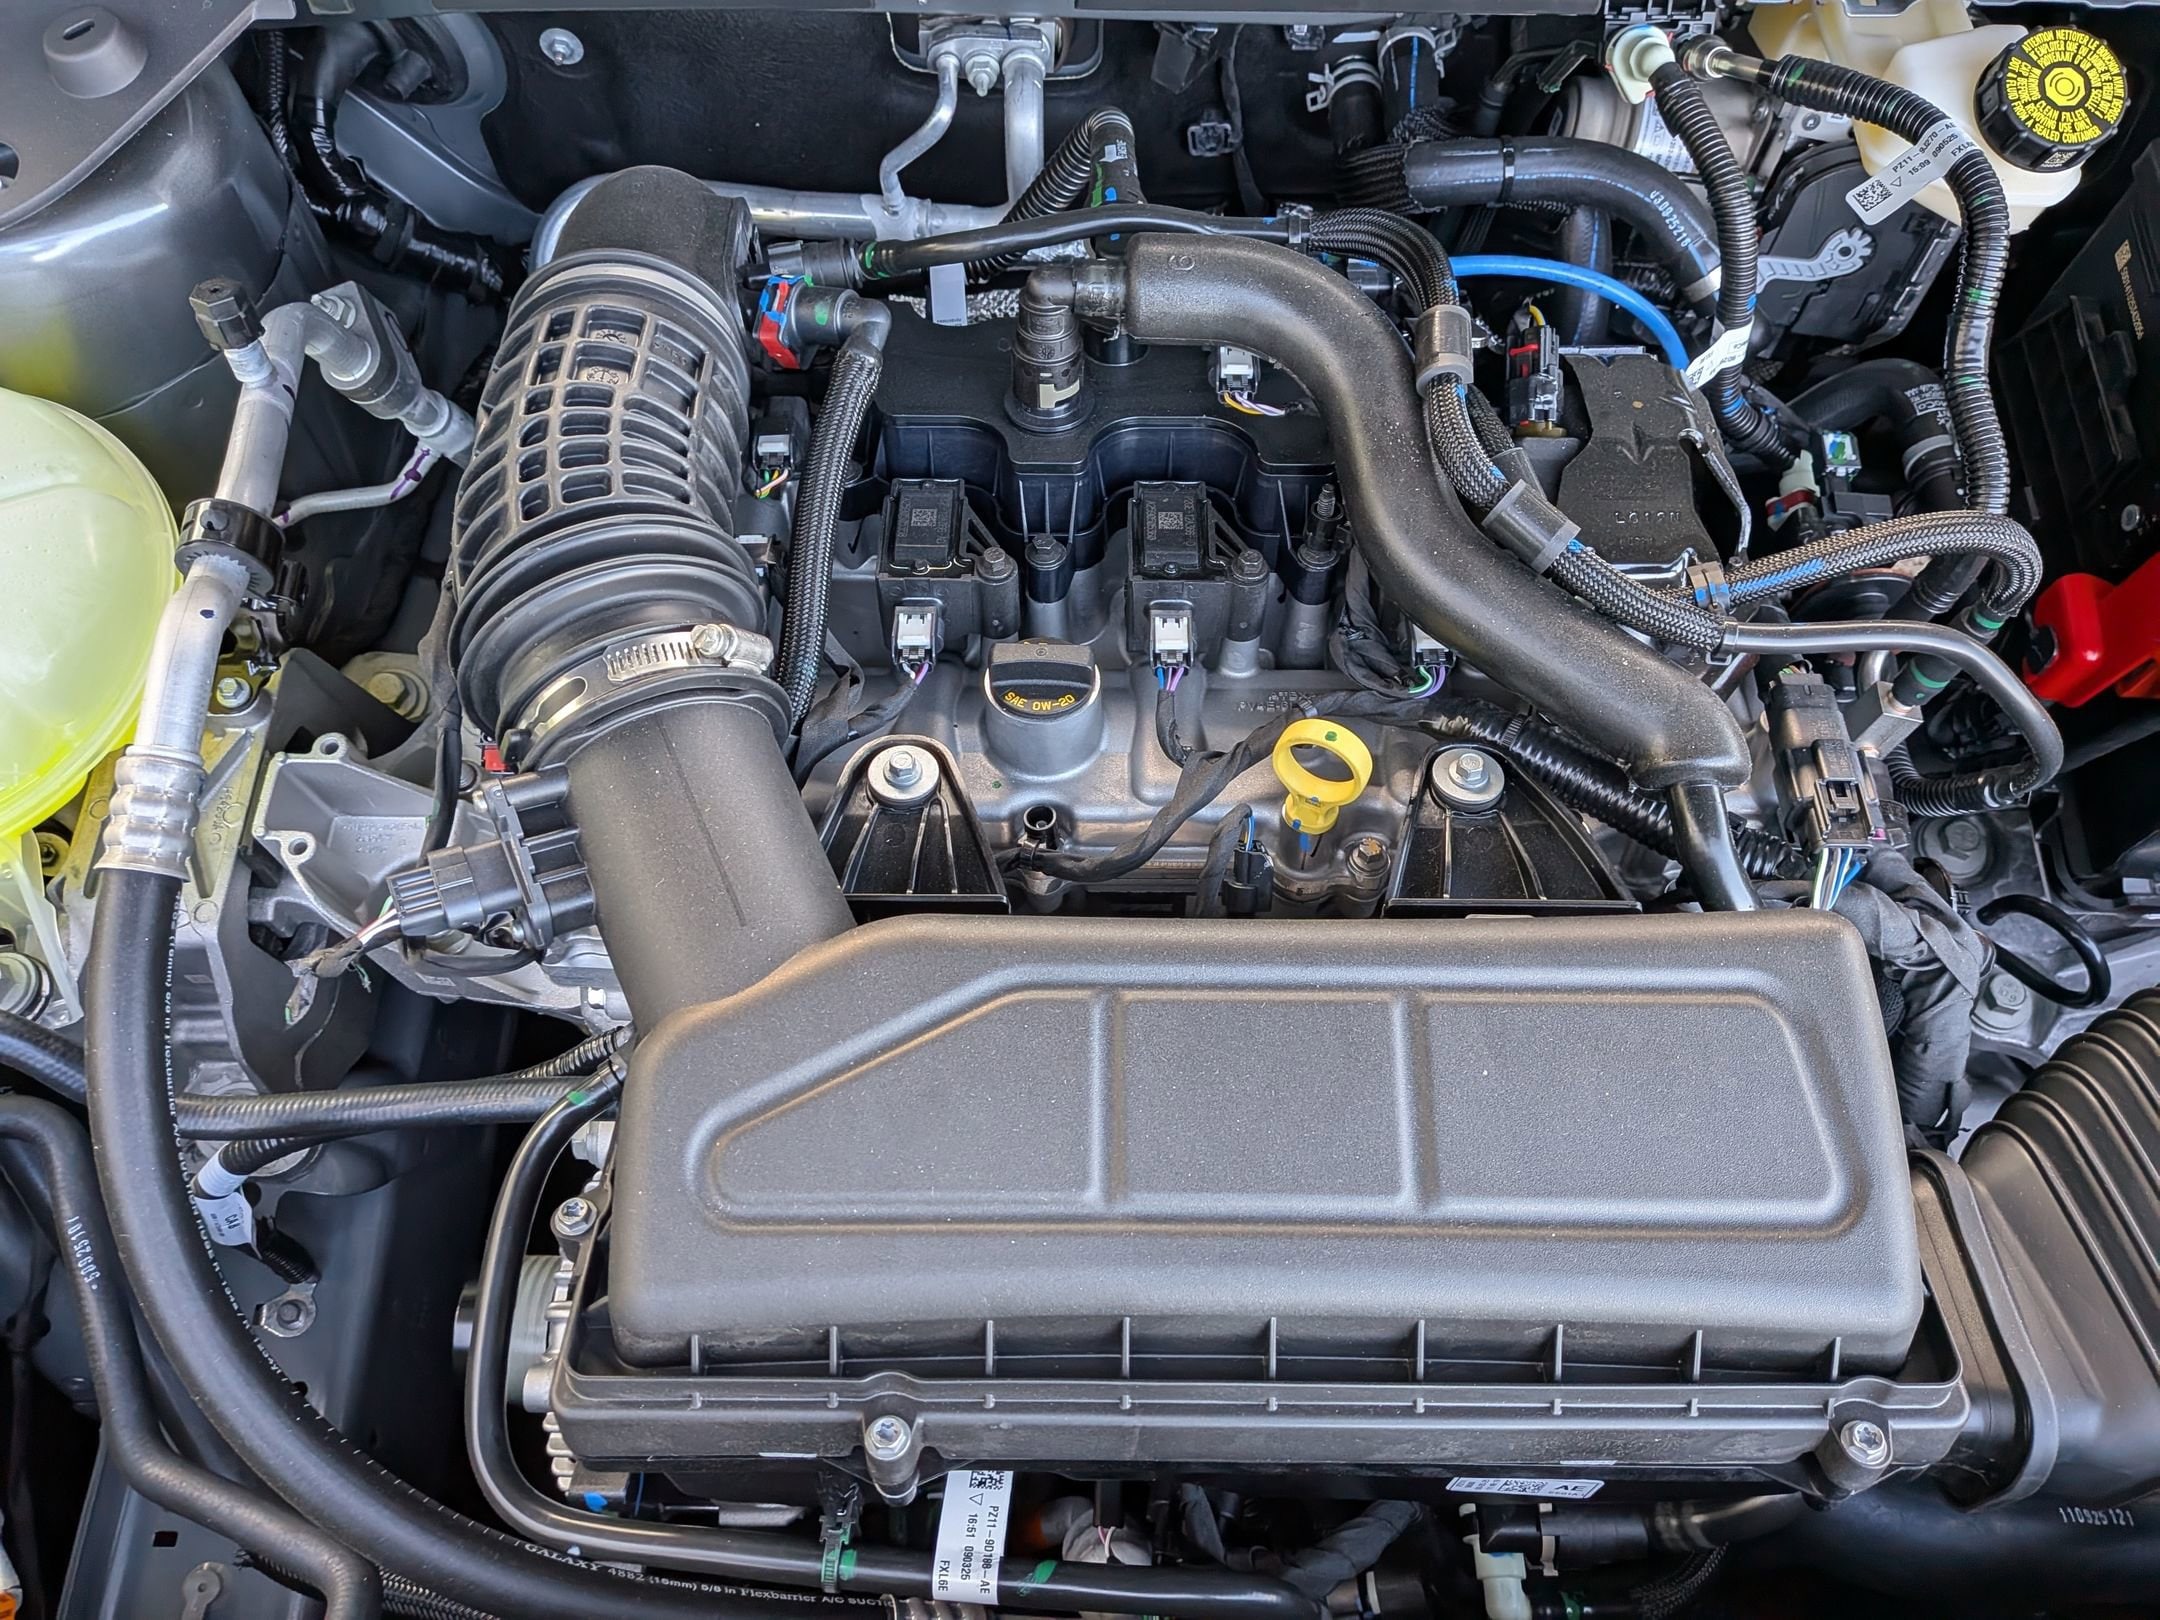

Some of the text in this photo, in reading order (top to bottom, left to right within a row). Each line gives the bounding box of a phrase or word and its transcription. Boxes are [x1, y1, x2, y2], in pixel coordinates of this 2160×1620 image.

[2088, 38, 2099, 50] LE
[2011, 100, 2029, 122] FROM
[2032, 125, 2060, 142] SEALED
[2035, 100, 2060, 121] CLEAN
[2061, 108, 2088, 122] FILLER
[2058, 121, 2073, 133] USE
[1004, 691, 1076, 711] SAE 0W-20
[1554, 1484, 1588, 1492] AE
[524, 1542, 602, 1572] GALAXY
[960, 1513, 978, 1581] 16:51 090325
[938, 1559, 951, 1592] FXL6E
